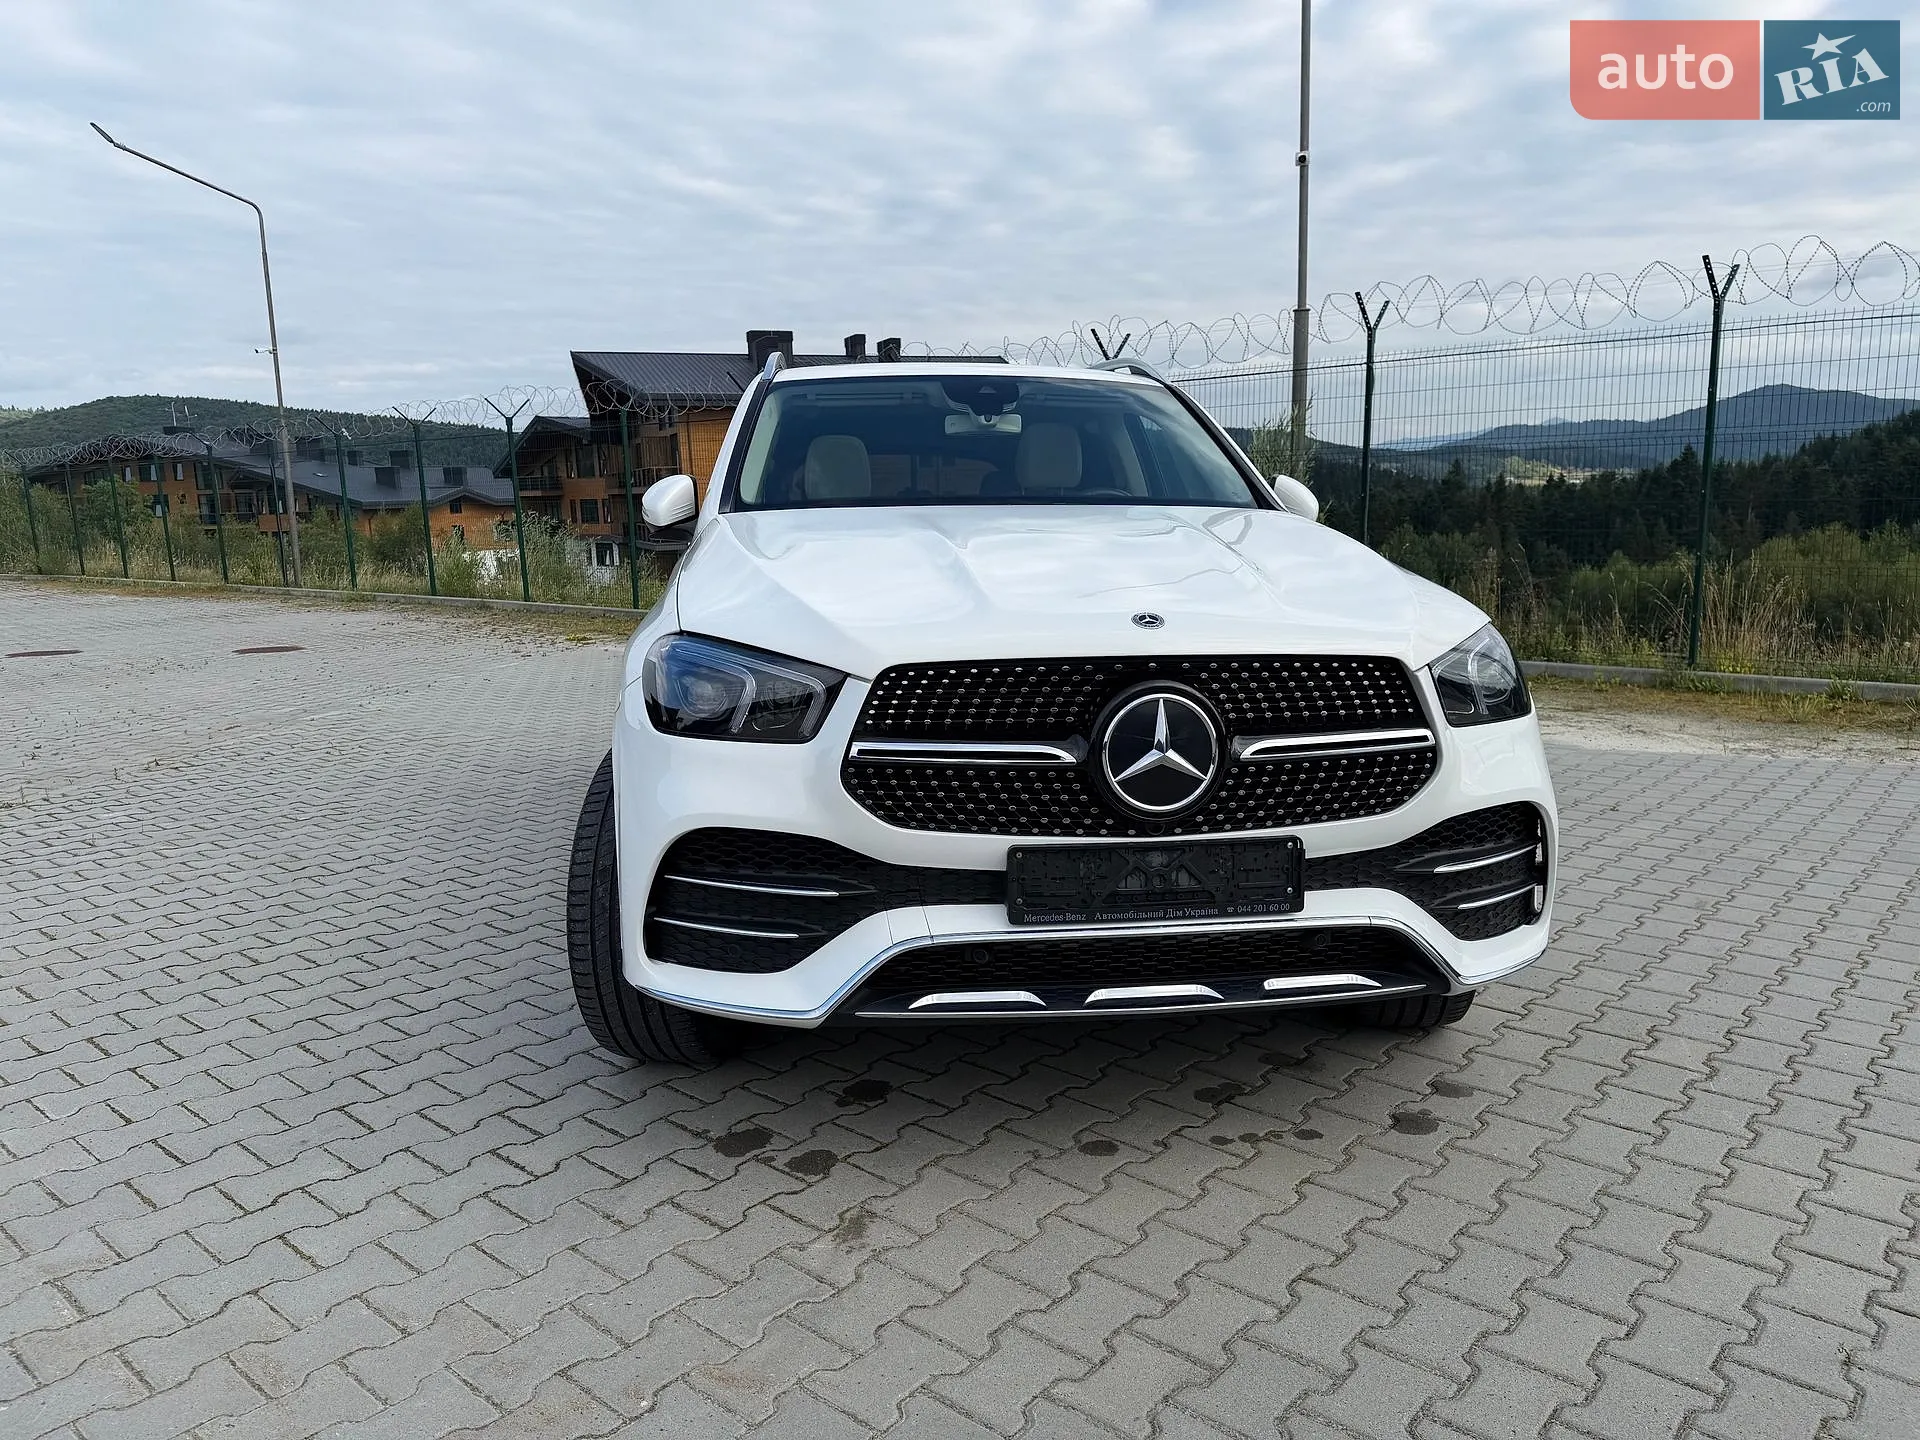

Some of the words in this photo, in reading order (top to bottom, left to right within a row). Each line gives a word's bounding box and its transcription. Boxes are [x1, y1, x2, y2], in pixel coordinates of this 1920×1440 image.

[1024, 912, 1087, 923] Mercedes-Benz
[1095, 909, 1164, 920] Автомобільний
[1166, 908, 1183, 918] Дім
[1185, 907, 1219, 918] Україна
[1237, 905, 1251, 913] 044
[1253, 904, 1267, 912] 201
[1269, 903, 1279, 912] 60
[1280, 903, 1290, 911] 00
